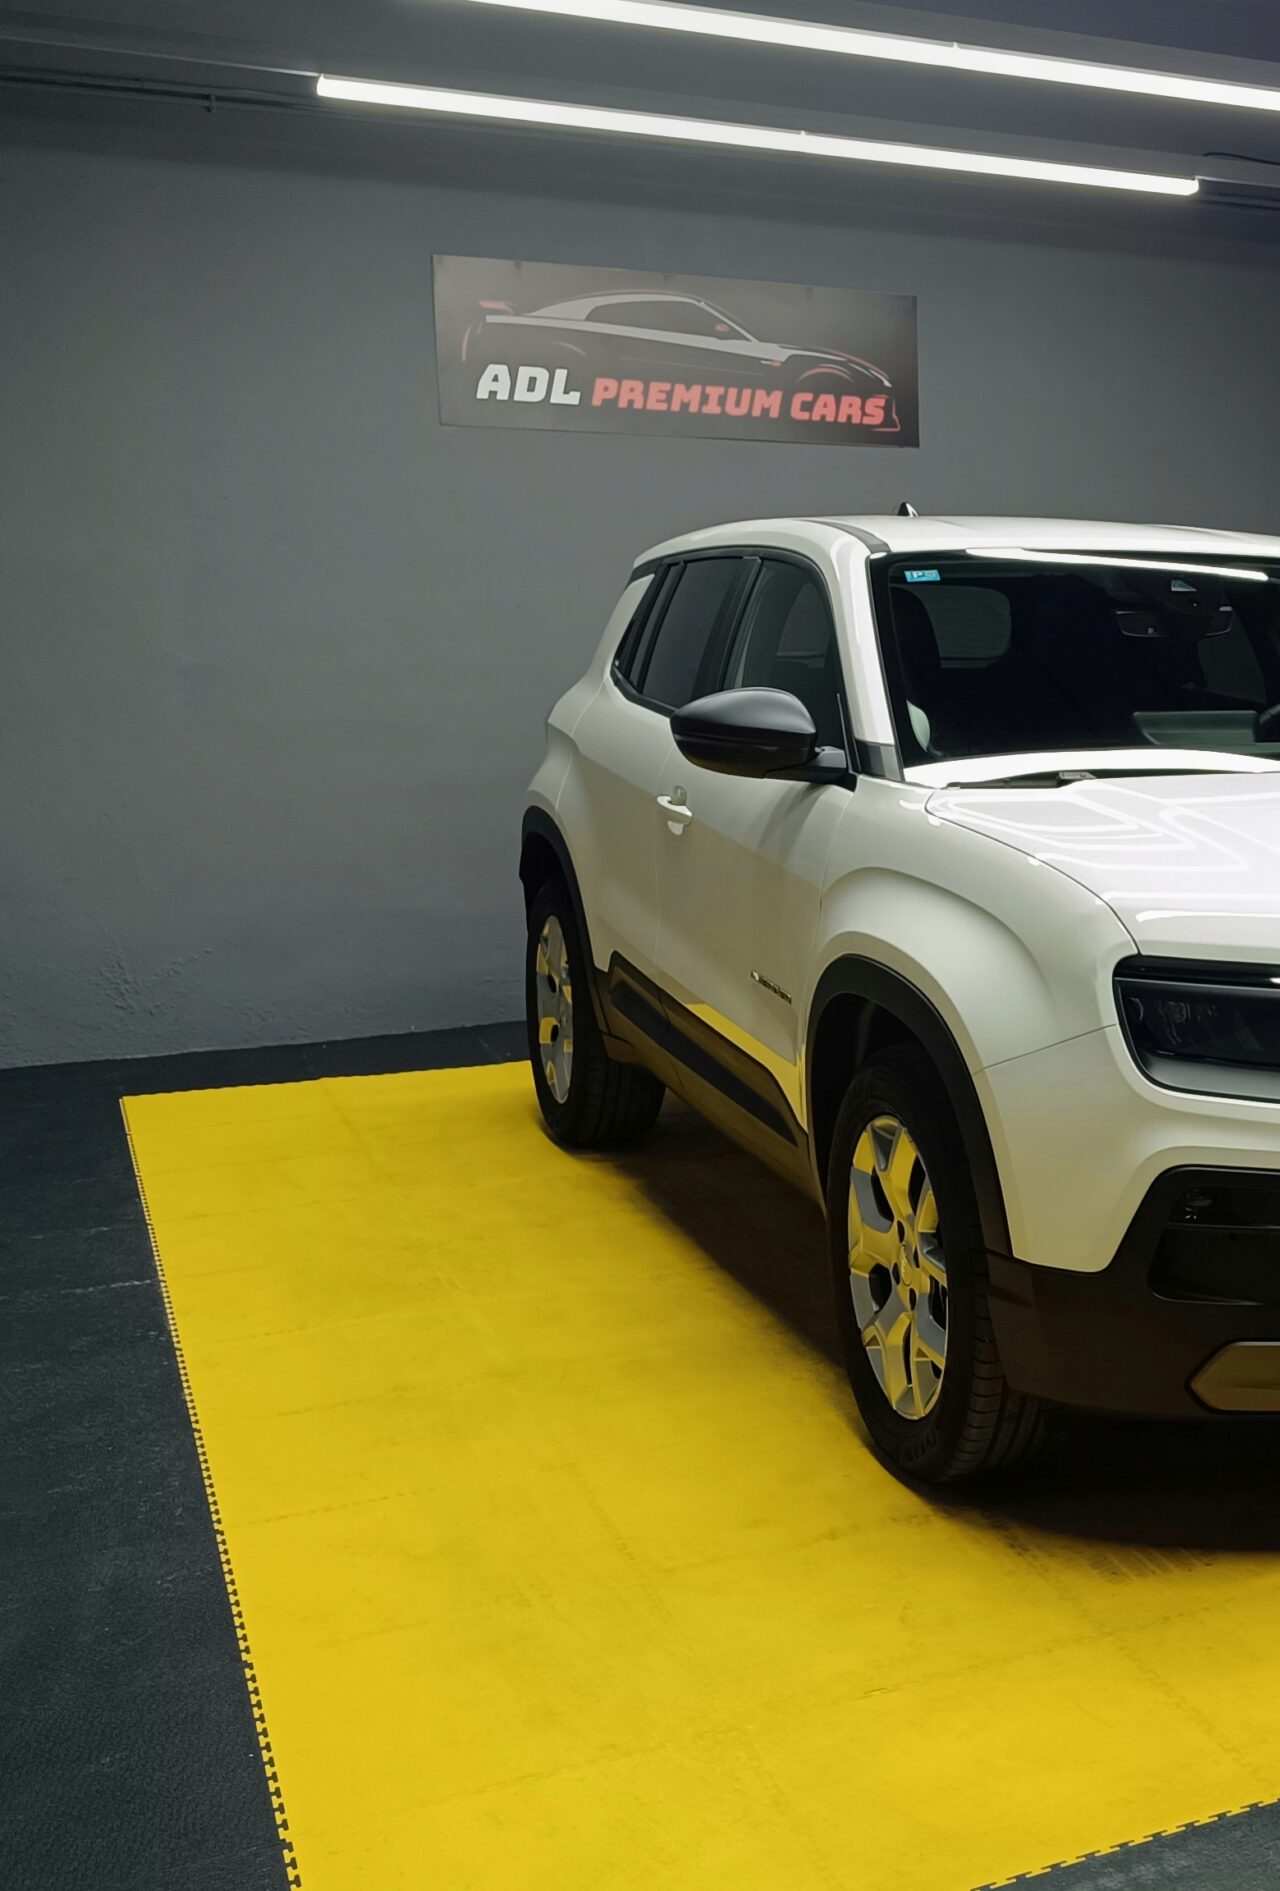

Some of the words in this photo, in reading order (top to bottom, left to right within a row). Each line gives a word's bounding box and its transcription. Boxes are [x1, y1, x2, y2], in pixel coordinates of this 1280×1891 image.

[475, 363, 582, 406] ADL
[591, 377, 784, 419] PREMIUM
[790, 393, 887, 426] CARS
